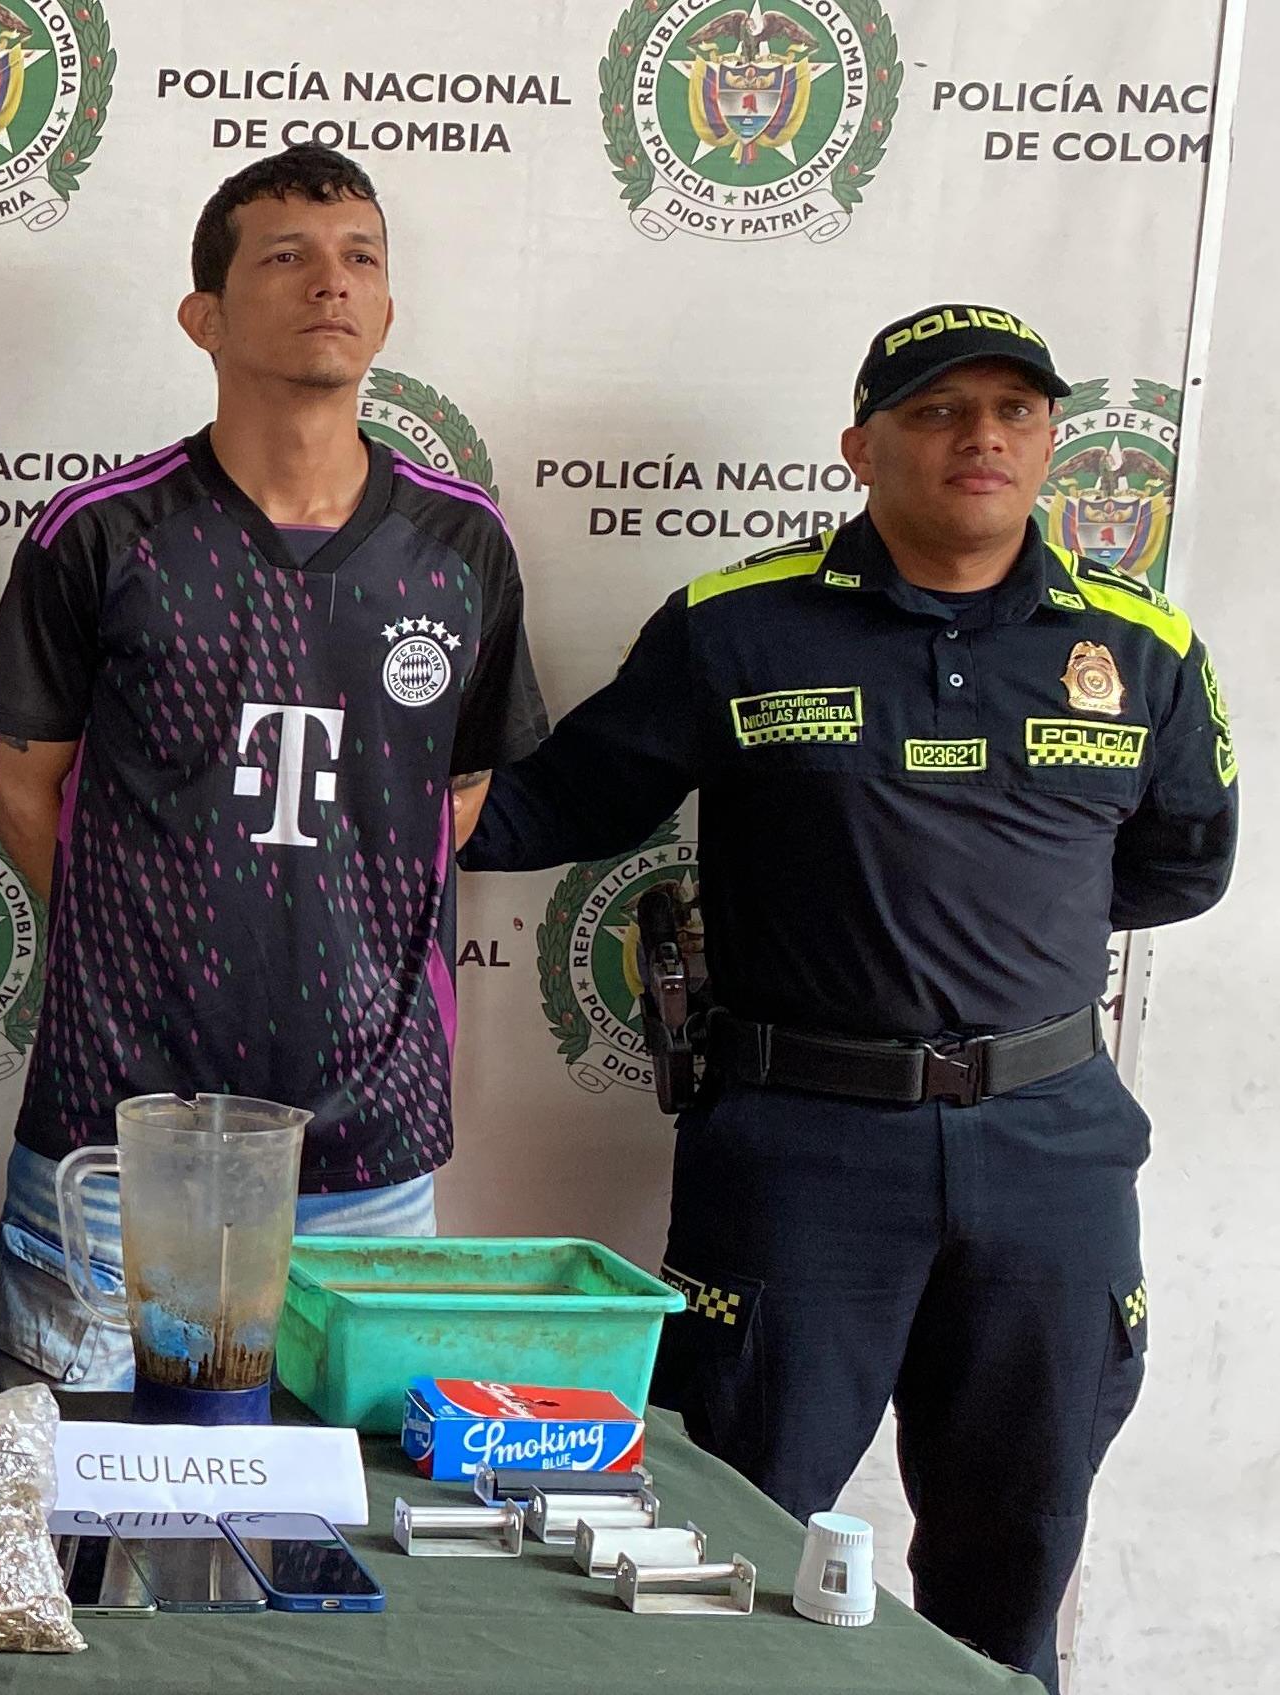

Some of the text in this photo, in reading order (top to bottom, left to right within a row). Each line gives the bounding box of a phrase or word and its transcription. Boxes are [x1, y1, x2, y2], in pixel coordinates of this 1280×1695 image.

[30, 0, 77, 96] LOMBIA
[638, 0, 710, 105] REPÚBLI
[157, 62, 571, 105] POLICÍA NACIONAL
[933, 75, 1103, 113] POLICÍA
[213, 119, 511, 153] DE COLOMBIA
[984, 131, 1211, 163] DE COLOM
[646, 135, 850, 205] POLICÍA NACIONAL
[742, 202, 819, 234] PATRIA
[1105, 412, 1136, 428] DE
[536, 453, 863, 493] POLICÍA NACIO
[589, 507, 847, 538] DE COLOMBI
[395, 644, 442, 671] FC BAYERN
[742, 705, 854, 730] NICOLAS ARRIETA
[912, 745, 979, 765] 023621
[1042, 728, 1134, 752] POLICÍA
[573, 857, 653, 967] REPÚBLICA
[582, 996, 651, 1056] POLICÍA
[602, 1055, 654, 1085] DIOS
[461, 1420, 604, 1475] Smoking
[542, 1453, 572, 1470] BLUE
[76, 1453, 267, 1486] CELULARES
